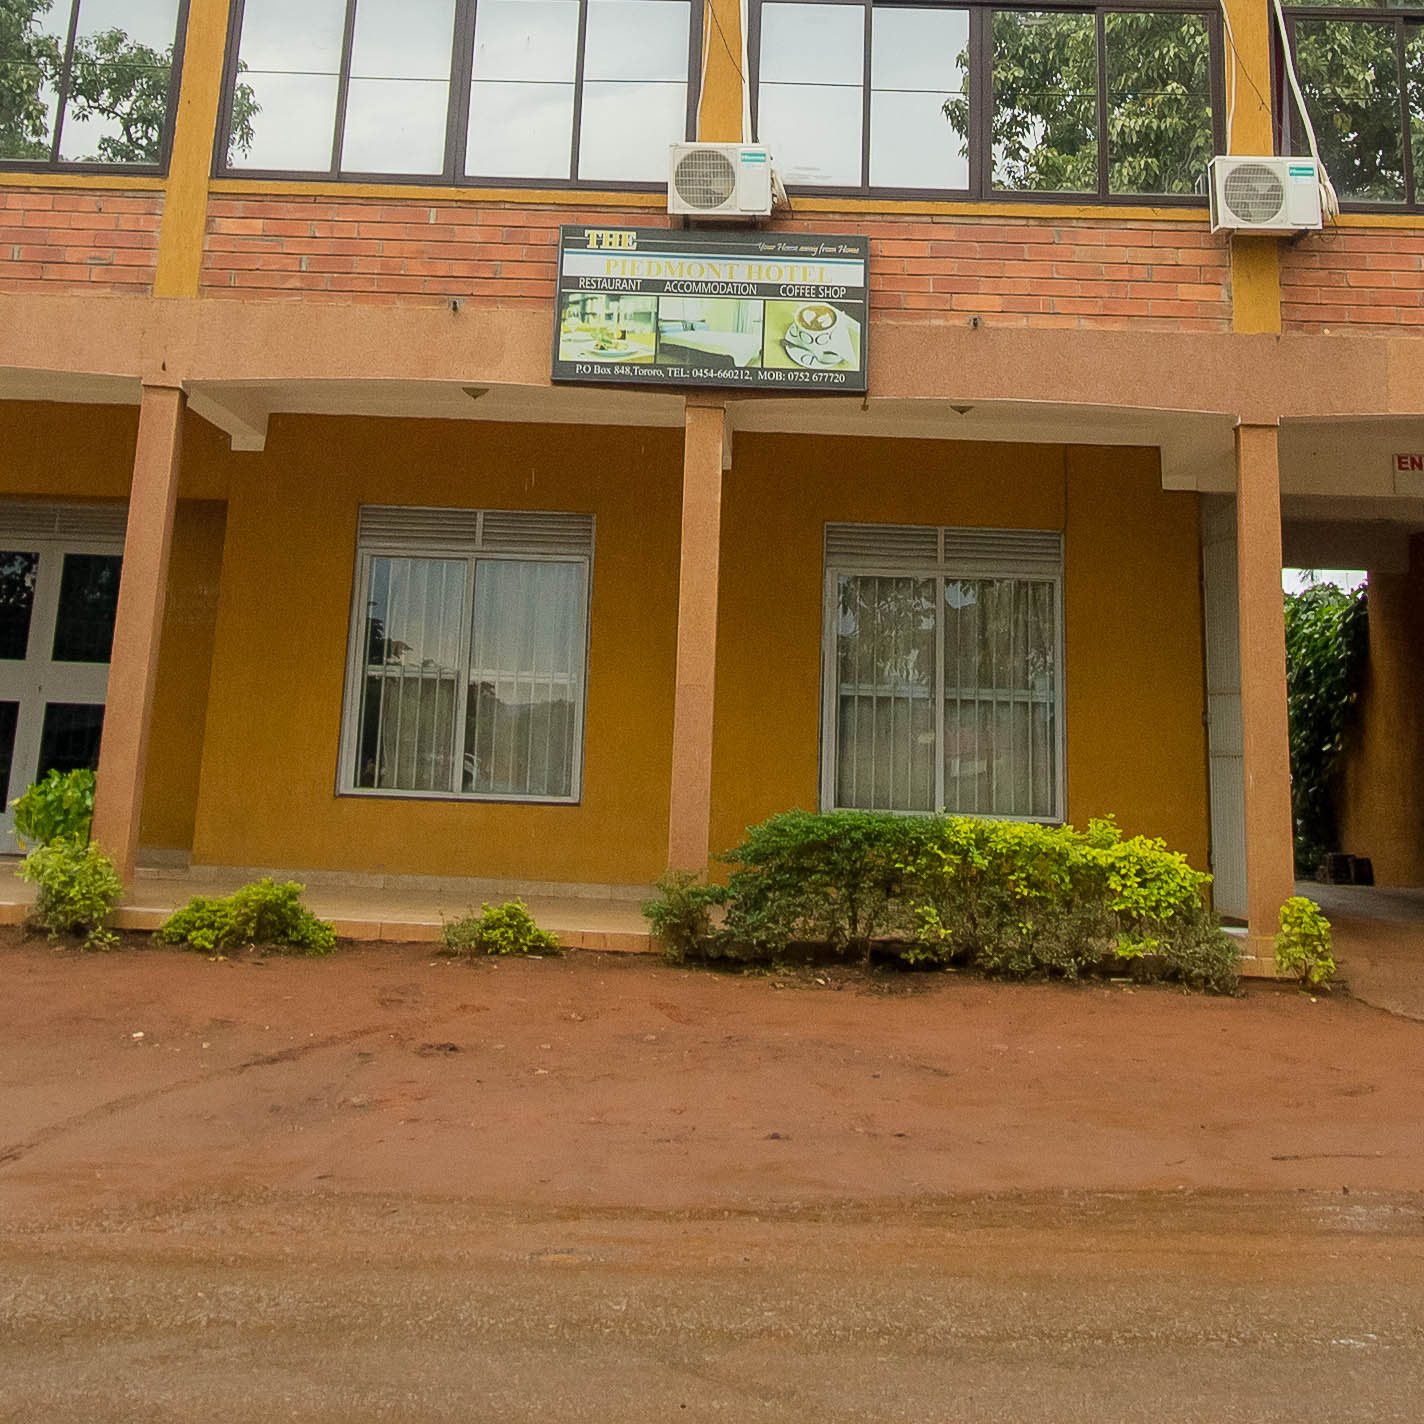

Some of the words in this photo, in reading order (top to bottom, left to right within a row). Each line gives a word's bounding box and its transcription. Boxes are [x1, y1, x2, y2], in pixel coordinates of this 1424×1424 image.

[585, 229, 637, 250] THE
[605, 258, 740, 280] PIEDMONT
[747, 263, 833, 283] HOTEL
[579, 277, 642, 291] RESTAURANT
[664, 281, 757, 295] ACCOMMODATION
[779, 284, 816, 297] COFFEE
[818, 286, 847, 298] SHOP
[575, 364, 591, 374] P.O
[593, 365, 612, 375] Box
[667, 367, 690, 377] TEL:
[758, 370, 786, 381] MOB:
[787, 372, 811, 382] 0752
[811, 373, 846, 383] 677720
